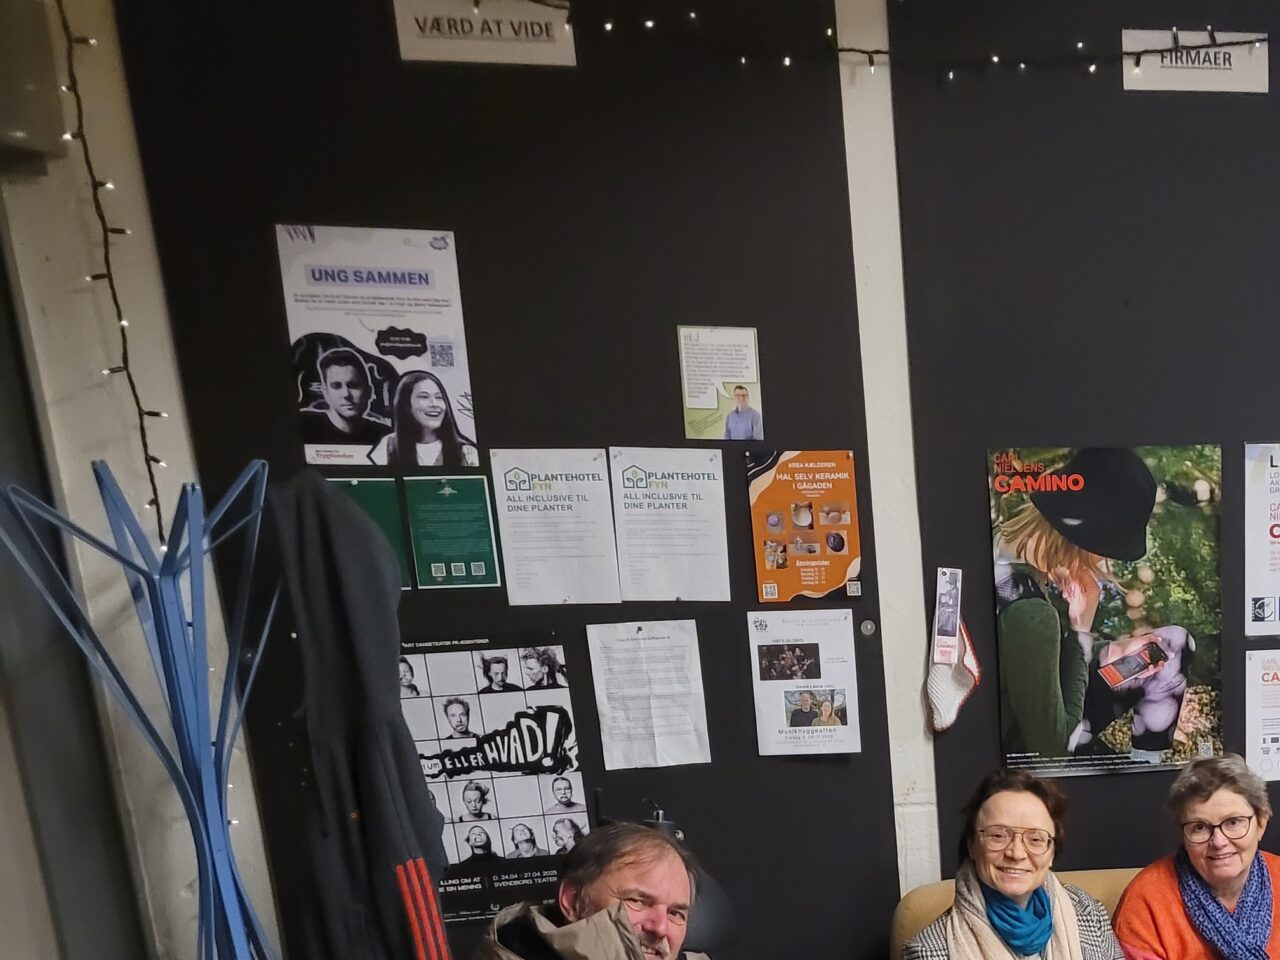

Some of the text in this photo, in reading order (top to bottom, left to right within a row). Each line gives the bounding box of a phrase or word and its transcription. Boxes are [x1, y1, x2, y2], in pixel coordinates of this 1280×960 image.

[414, 16, 554, 38] VÆRD AT VIDE
[1160, 50, 1232, 67] FIRMAER
[311, 269, 430, 285] UNG SAMMEN
[530, 473, 604, 482] PLANTEHOTEL
[647, 472, 718, 481] PLANTEHOTEL
[815, 472, 850, 480] KERAMIK
[531, 482, 552, 491] FYN
[648, 481, 668, 489] FYN
[796, 481, 833, 489] GÅGADEN
[994, 474, 1085, 492] CAMINO
[526, 494, 574, 502] INCLUSIVE
[575, 494, 590, 502] TIL
[691, 493, 704, 501] TIL
[507, 504, 574, 512] DINE PLANTER
[624, 502, 688, 510] DINE PLANTER
[444, 753, 485, 769] ELLER
[484, 711, 560, 767] HVAD!
[493, 880, 533, 888] SVENDBORG
